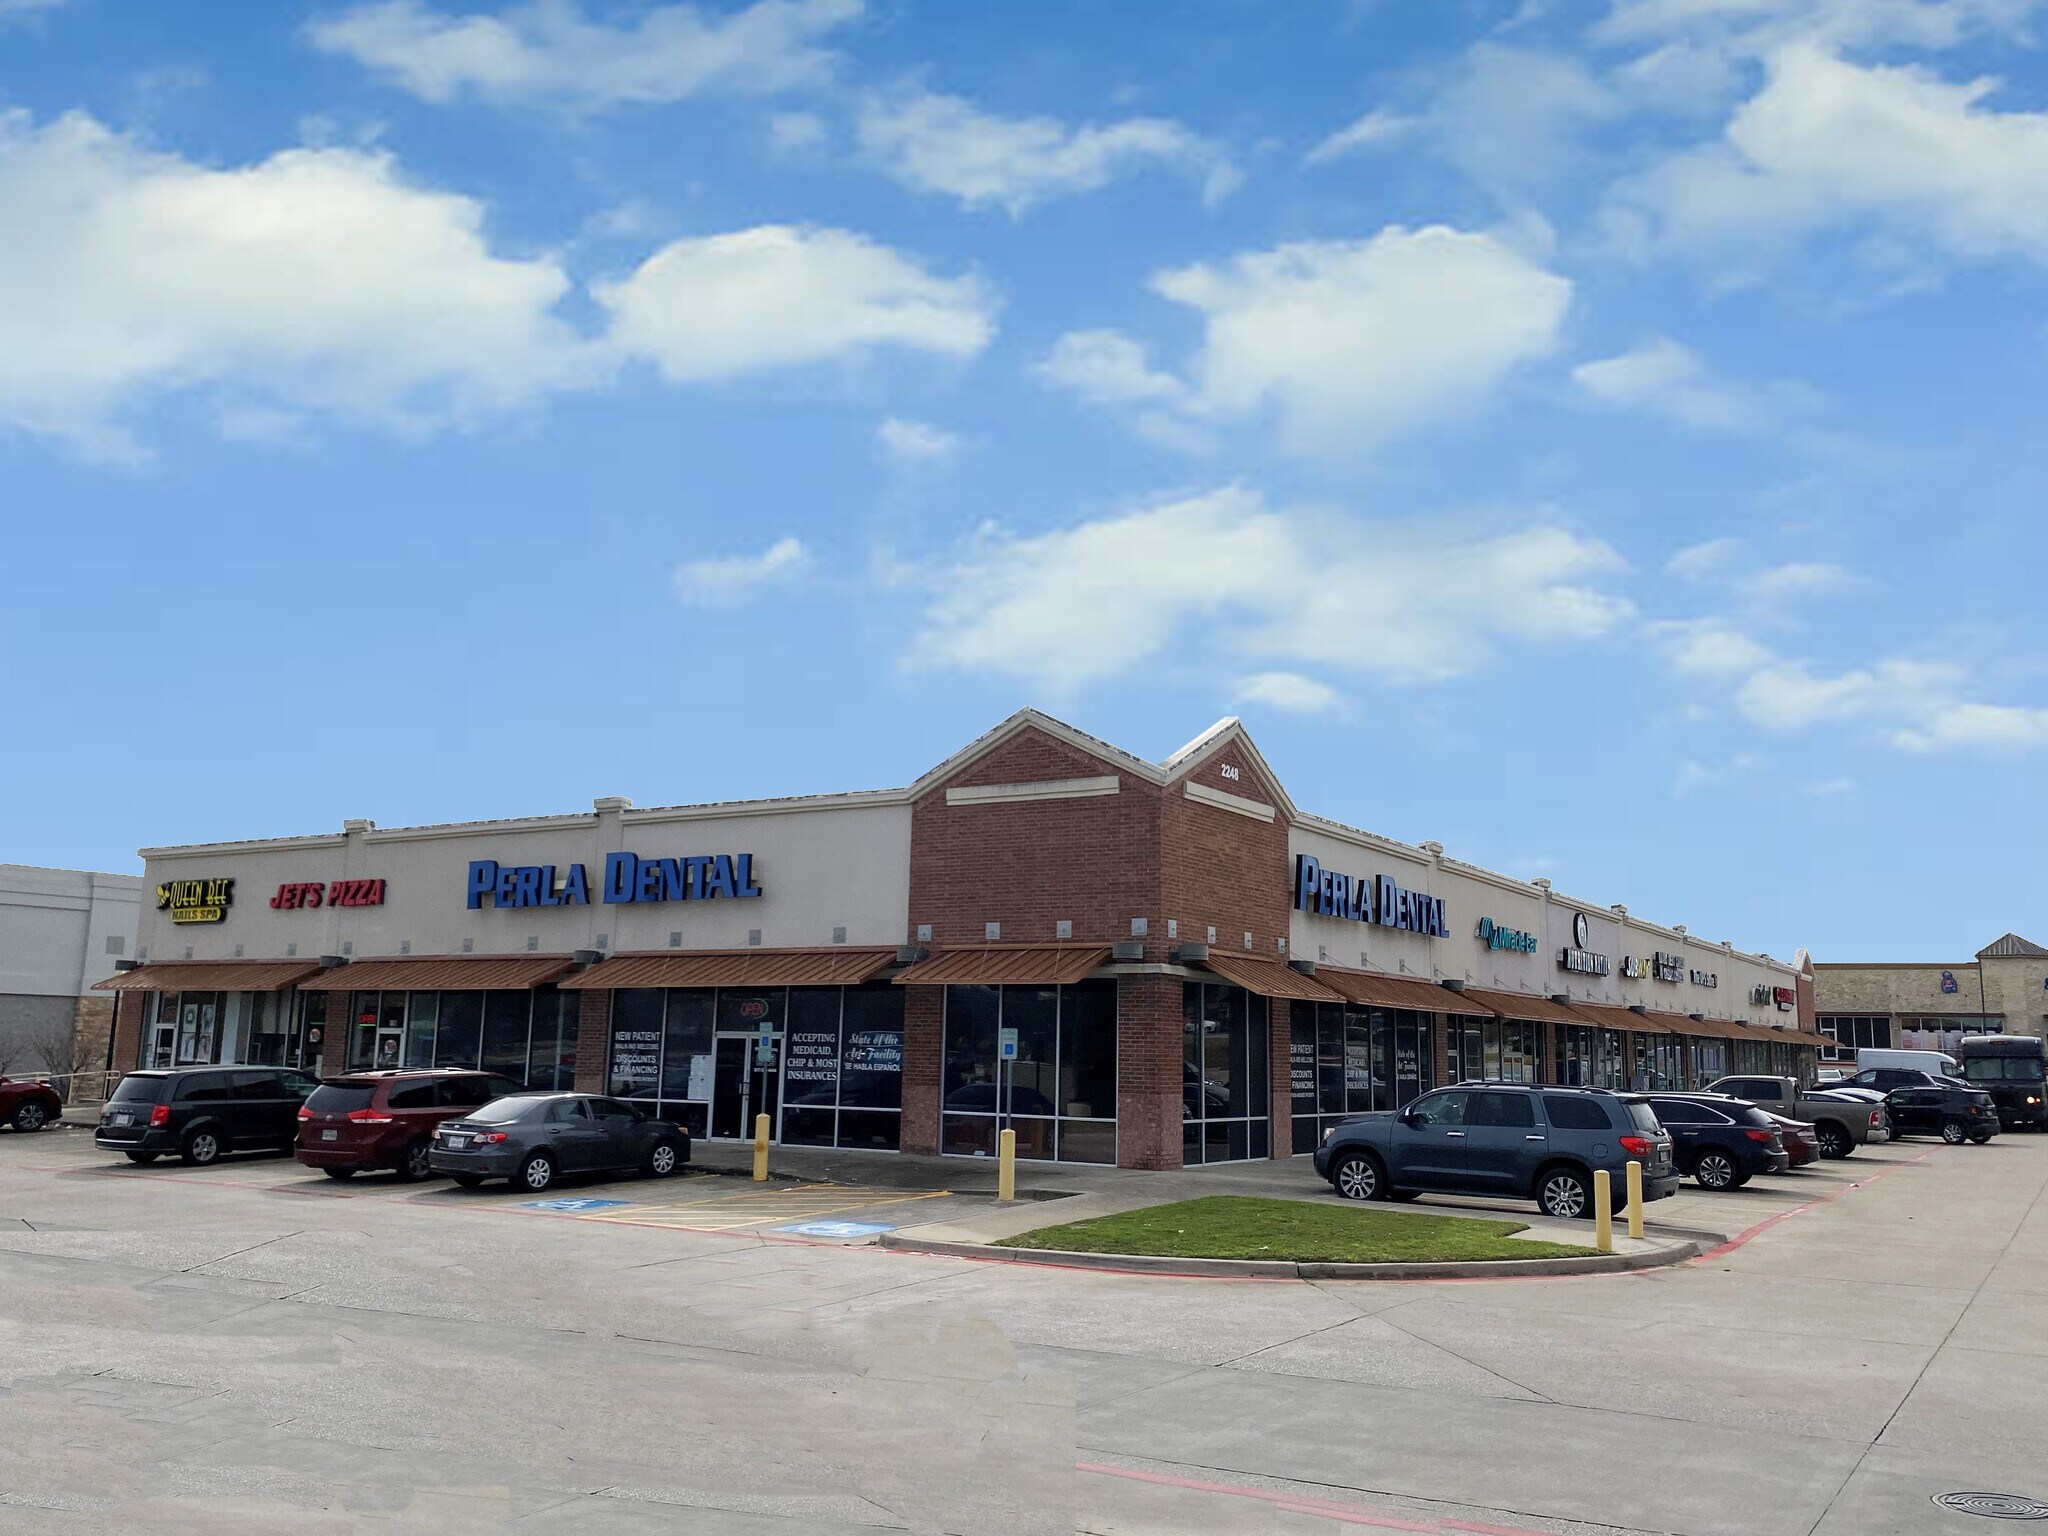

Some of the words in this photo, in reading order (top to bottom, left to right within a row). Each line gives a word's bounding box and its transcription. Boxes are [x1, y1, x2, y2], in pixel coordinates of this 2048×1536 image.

[1221, 763, 1239, 781] 2248
[467, 860, 590, 909] PERLA
[603, 851, 762, 904] DENTAL
[169, 881, 202, 908] QUEEN
[206, 879, 228, 905] BEE
[269, 882, 325, 909] JET'S
[327, 879, 386, 906] PIZZA
[1294, 854, 1373, 923] PERLA
[1375, 874, 1449, 938] DENTAL
[172, 910, 198, 920] NAILS
[200, 909, 218, 919] SPA
[741, 1003, 764, 1016] OPEN
[615, 1031, 632, 1041] NEW
[632, 1031, 661, 1041] PATIENT
[792, 1033, 836, 1043] ACCEPTING
[873, 1034, 883, 1046] of
[885, 1034, 899, 1045] the
[792, 1045, 834, 1056] MEDICAID,
[616, 1054, 657, 1064] DISCOUNTS
[787, 1058, 807, 1067] CHIP
[807, 1059, 814, 1067] &
[815, 1059, 838, 1068] MOST
[613, 1065, 619, 1073] &
[620, 1066, 658, 1074] FINANCING
[853, 1063, 873, 1071] HABLA
[874, 1061, 901, 1071] ESPAÑOL
[787, 1070, 837, 1080] INSURANCES
